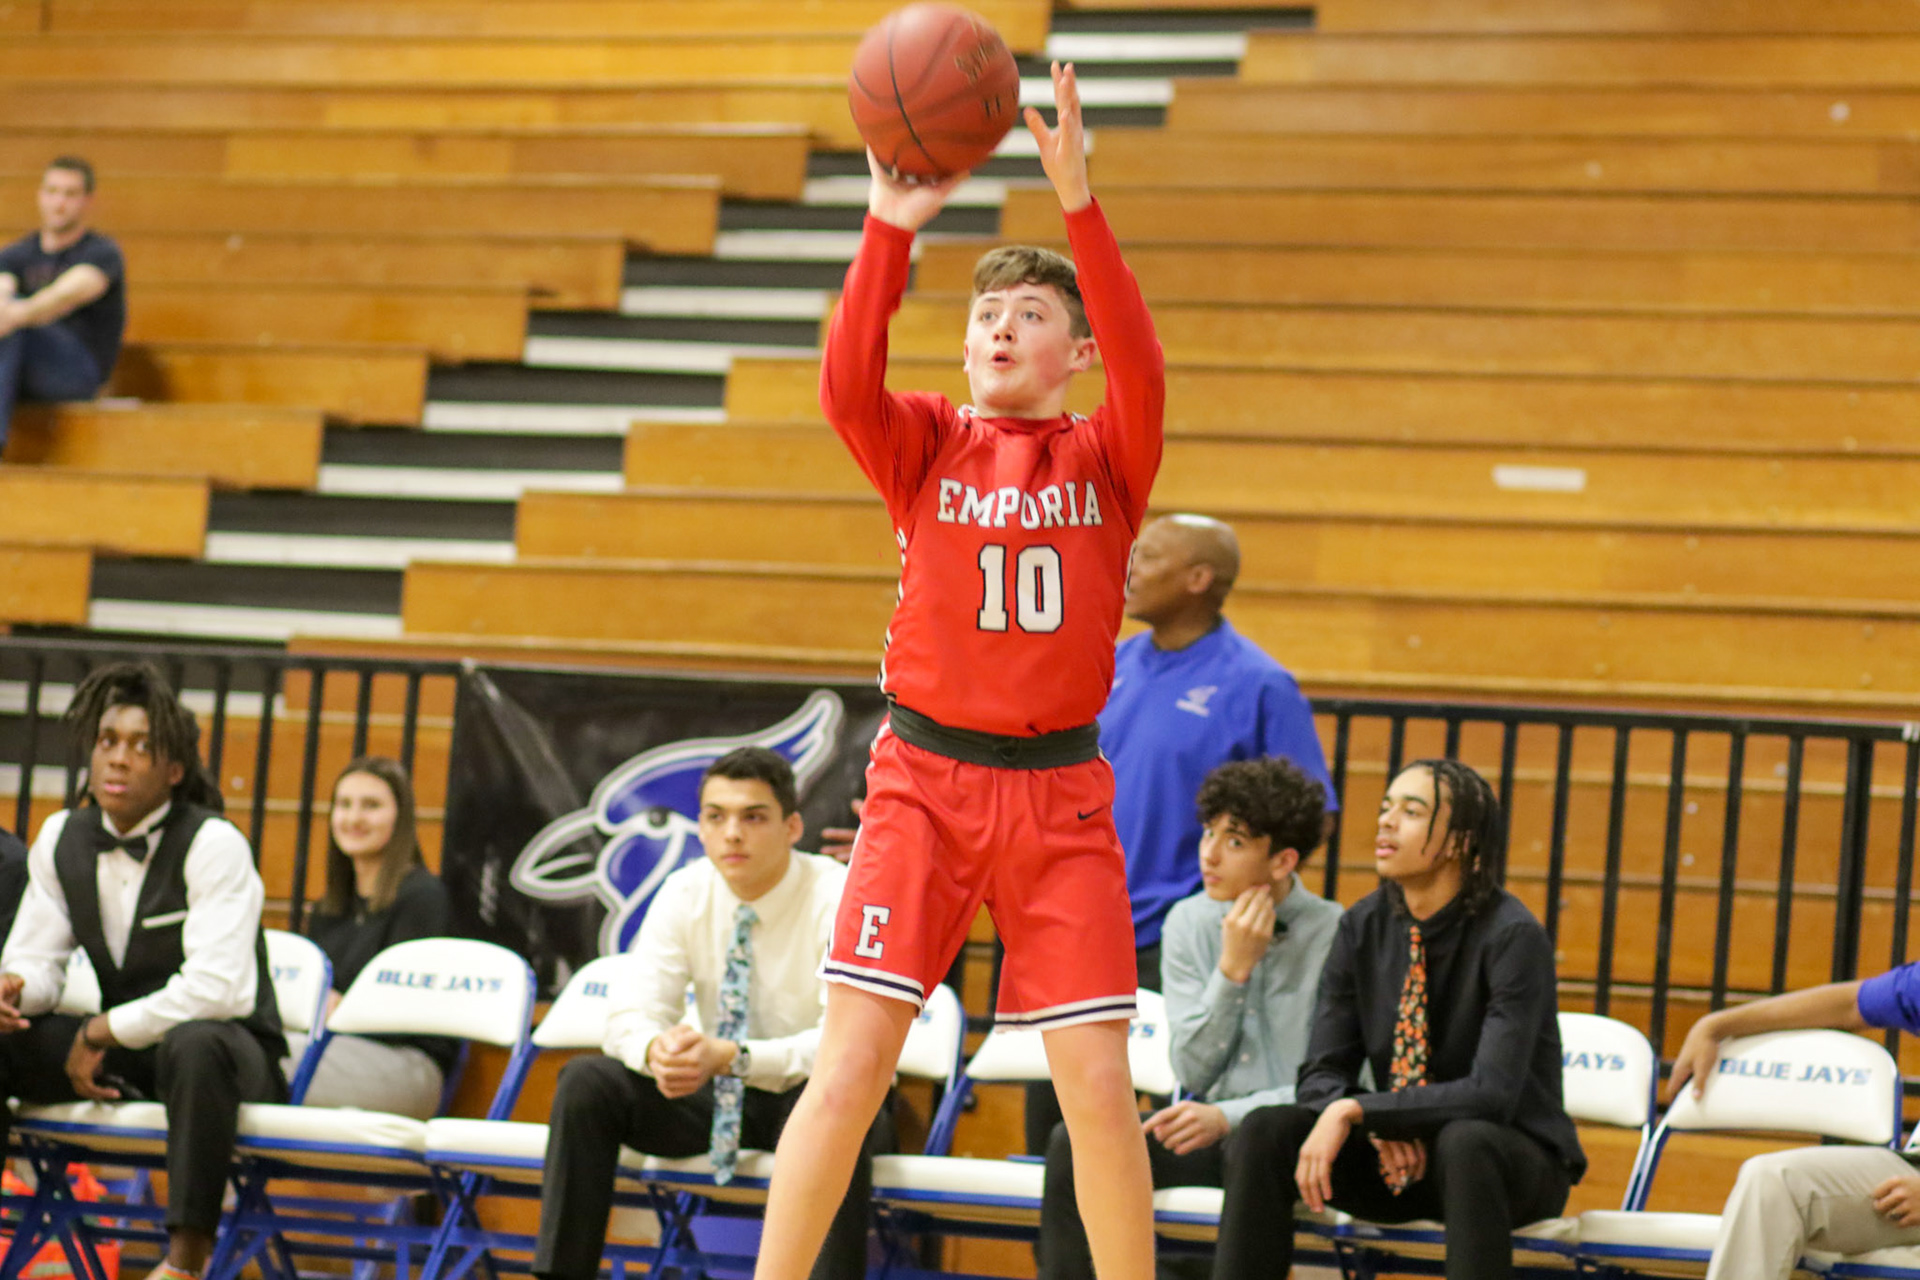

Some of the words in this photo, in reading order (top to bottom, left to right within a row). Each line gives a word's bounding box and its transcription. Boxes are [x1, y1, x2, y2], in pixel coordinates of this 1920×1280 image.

[937, 477, 1103, 531] EMPORIA
[976, 543, 1064, 633] 10
[854, 904, 892, 960] E
[376, 968, 437, 990] BLUE
[443, 975, 505, 993] JAYS
[582, 981, 609, 998] BL
[1718, 1057, 1792, 1081] BLUE
[1797, 1063, 1873, 1086] JAYS
